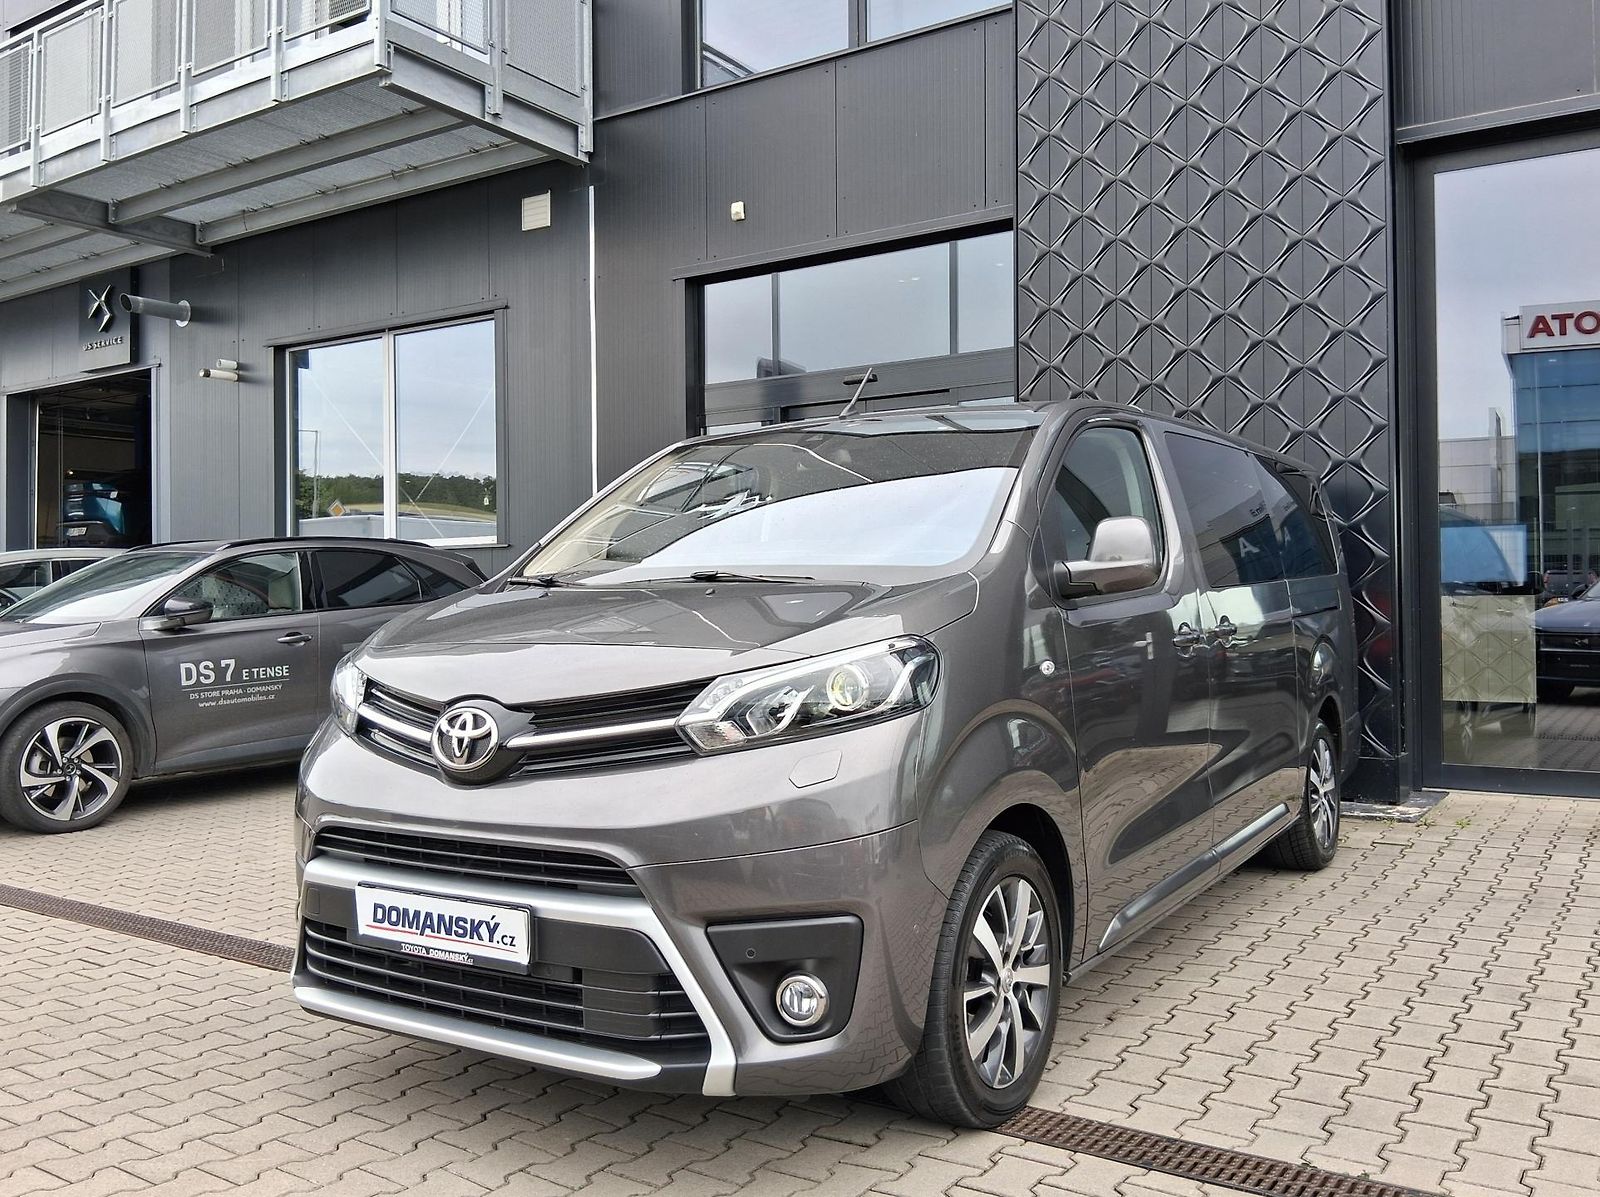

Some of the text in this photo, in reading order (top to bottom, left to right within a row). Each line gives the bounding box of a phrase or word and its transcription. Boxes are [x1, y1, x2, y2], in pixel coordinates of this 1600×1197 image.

[93, 336, 123, 349] SERVICE
[180, 659, 289, 686] DS 7 E TENSE
[189, 692, 199, 700] DS
[200, 690, 220, 699] STORE
[221, 688, 243, 697] PRAHA
[198, 694, 276, 708] www.dsautomobiles.cz
[401, 943, 427, 955] TOYOTA
